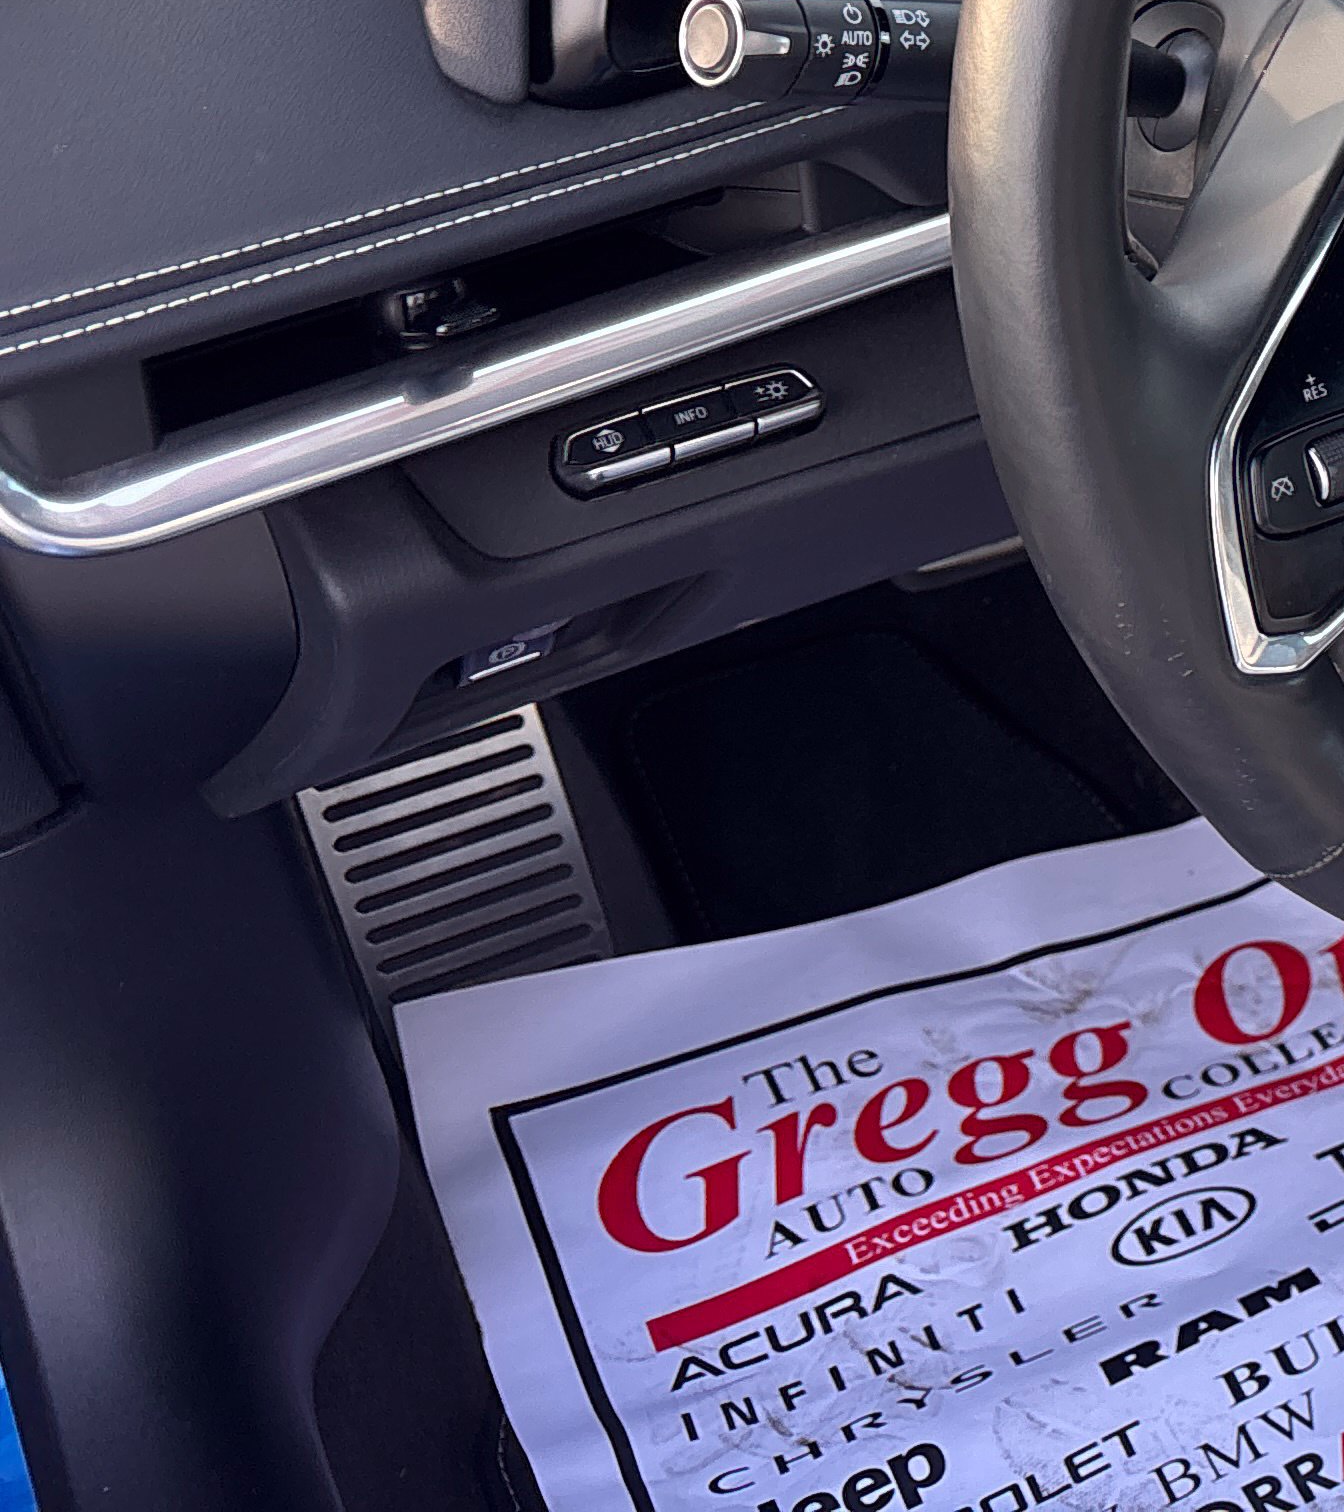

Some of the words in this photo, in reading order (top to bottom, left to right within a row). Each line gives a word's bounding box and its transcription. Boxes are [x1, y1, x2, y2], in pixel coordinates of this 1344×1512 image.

[841, 29, 873, 47] AUTO
[593, 430, 624, 452] HUD
[674, 406, 709, 425] INFO
[1303, 383, 1328, 403] RES
[596, 1019, 1150, 1253] Gregg
[743, 1048, 883, 1106] The
[763, 1168, 935, 1259] AUTO
[845, 1179, 1025, 1265] Exceeding
[1027, 1106, 1230, 1194] Expectations
[1002, 1126, 1288, 1252] HONDA
[1136, 1196, 1240, 1258] KIA
[669, 1272, 926, 1392] ACURA
[680, 1287, 1026, 1442] INFINITI
[1098, 1266, 1321, 1387] RAM
[707, 1291, 1166, 1495] CHRYSLER
[1147, 1388, 1317, 1507] BMW
